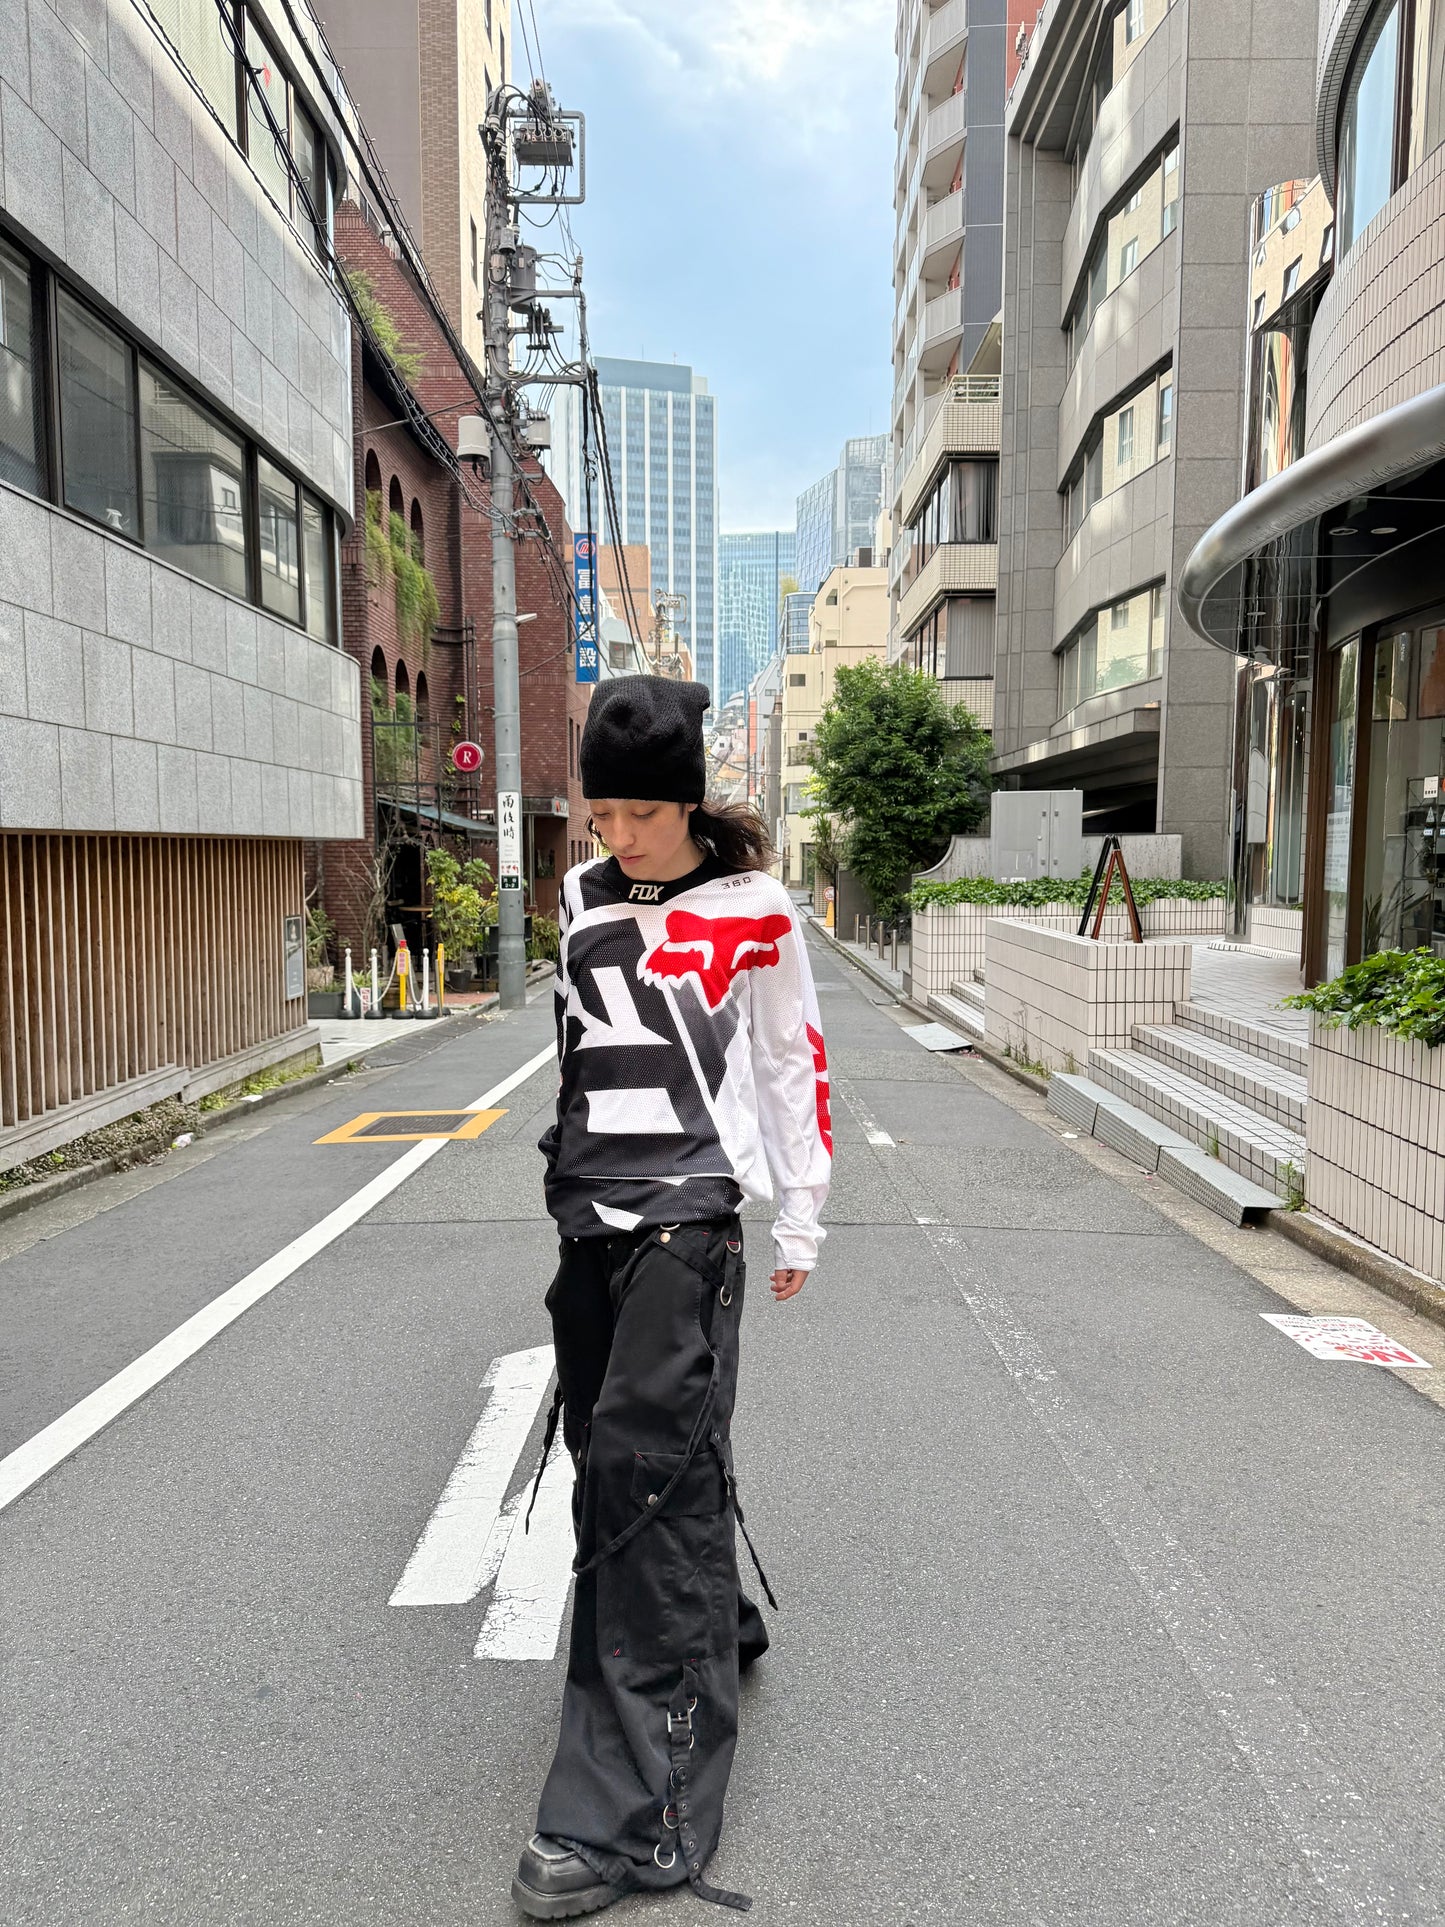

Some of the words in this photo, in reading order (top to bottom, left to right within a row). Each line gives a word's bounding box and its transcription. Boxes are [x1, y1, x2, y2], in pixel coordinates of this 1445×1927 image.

[463, 750, 472, 764] R
[721, 876, 751, 889] 360
[628, 884, 664, 900] FOX
